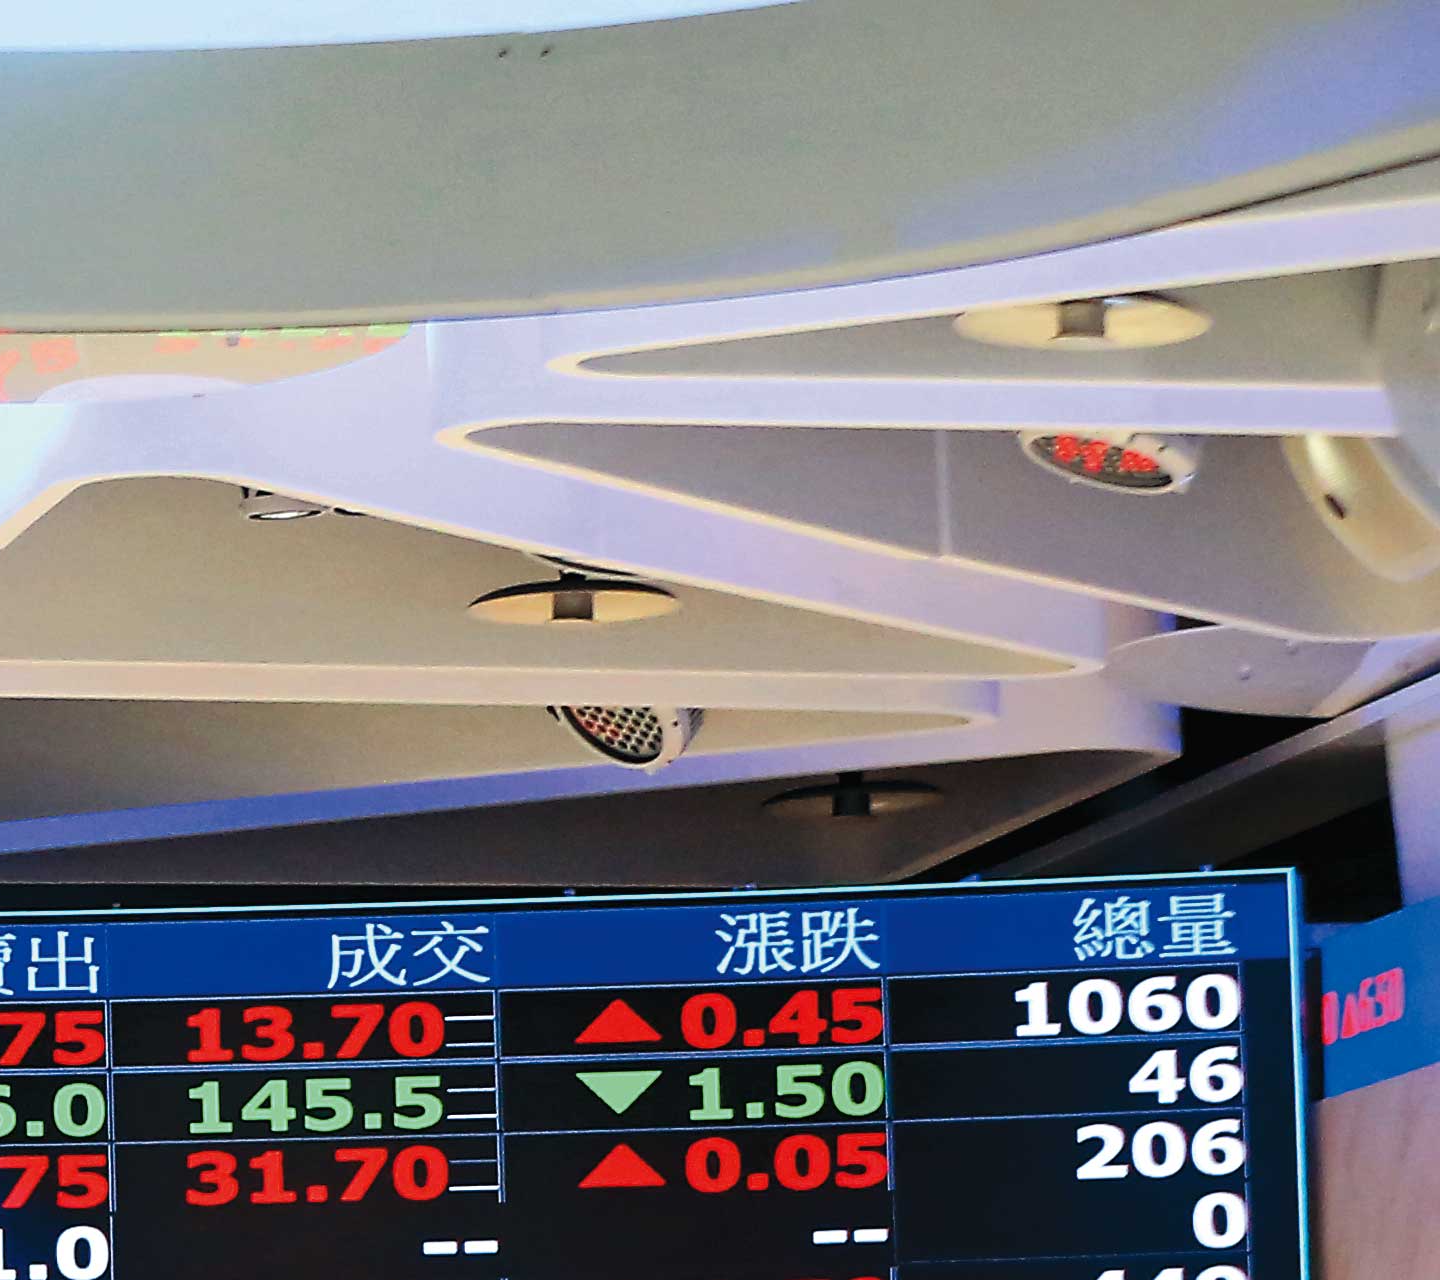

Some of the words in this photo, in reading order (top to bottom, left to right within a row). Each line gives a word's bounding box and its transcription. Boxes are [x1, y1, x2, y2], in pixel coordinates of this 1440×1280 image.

[328, 921, 490, 989] 成交
[715, 907, 878, 974] 漲跌
[1073, 893, 1237, 961] 總量
[188, 1002, 444, 1062] 13.70
[682, 988, 884, 1048] 0.45
[1016, 975, 1240, 1035] 1060
